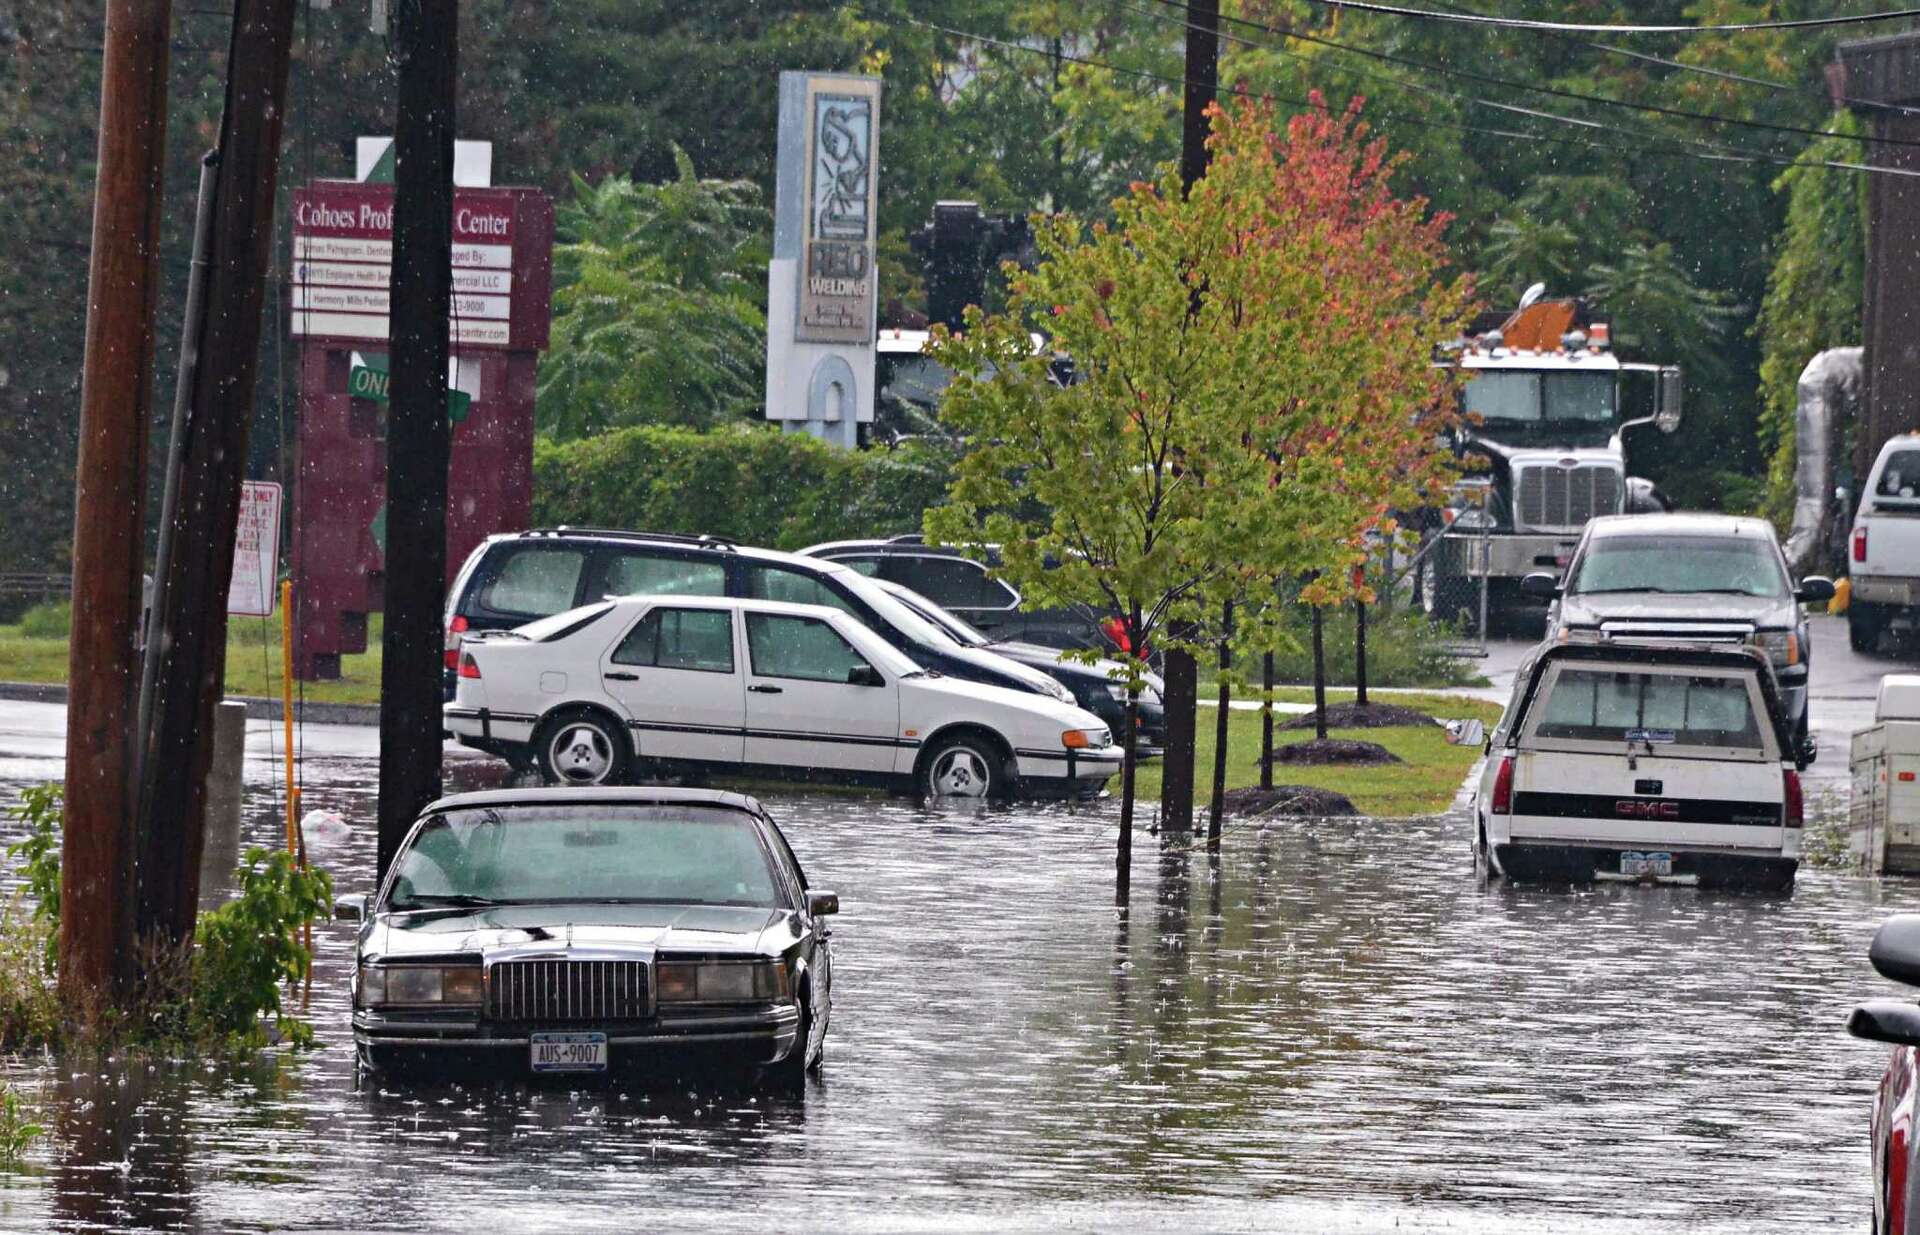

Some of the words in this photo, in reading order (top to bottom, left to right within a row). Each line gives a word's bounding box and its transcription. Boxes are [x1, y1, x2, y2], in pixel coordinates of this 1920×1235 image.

[298, 201, 355, 228] Cohoes
[457, 208, 509, 234] Center
[483, 276, 500, 288] LLC
[811, 278, 868, 297] WELDING
[1615, 801, 1679, 817] GMC
[569, 1044, 599, 1062] 9007
